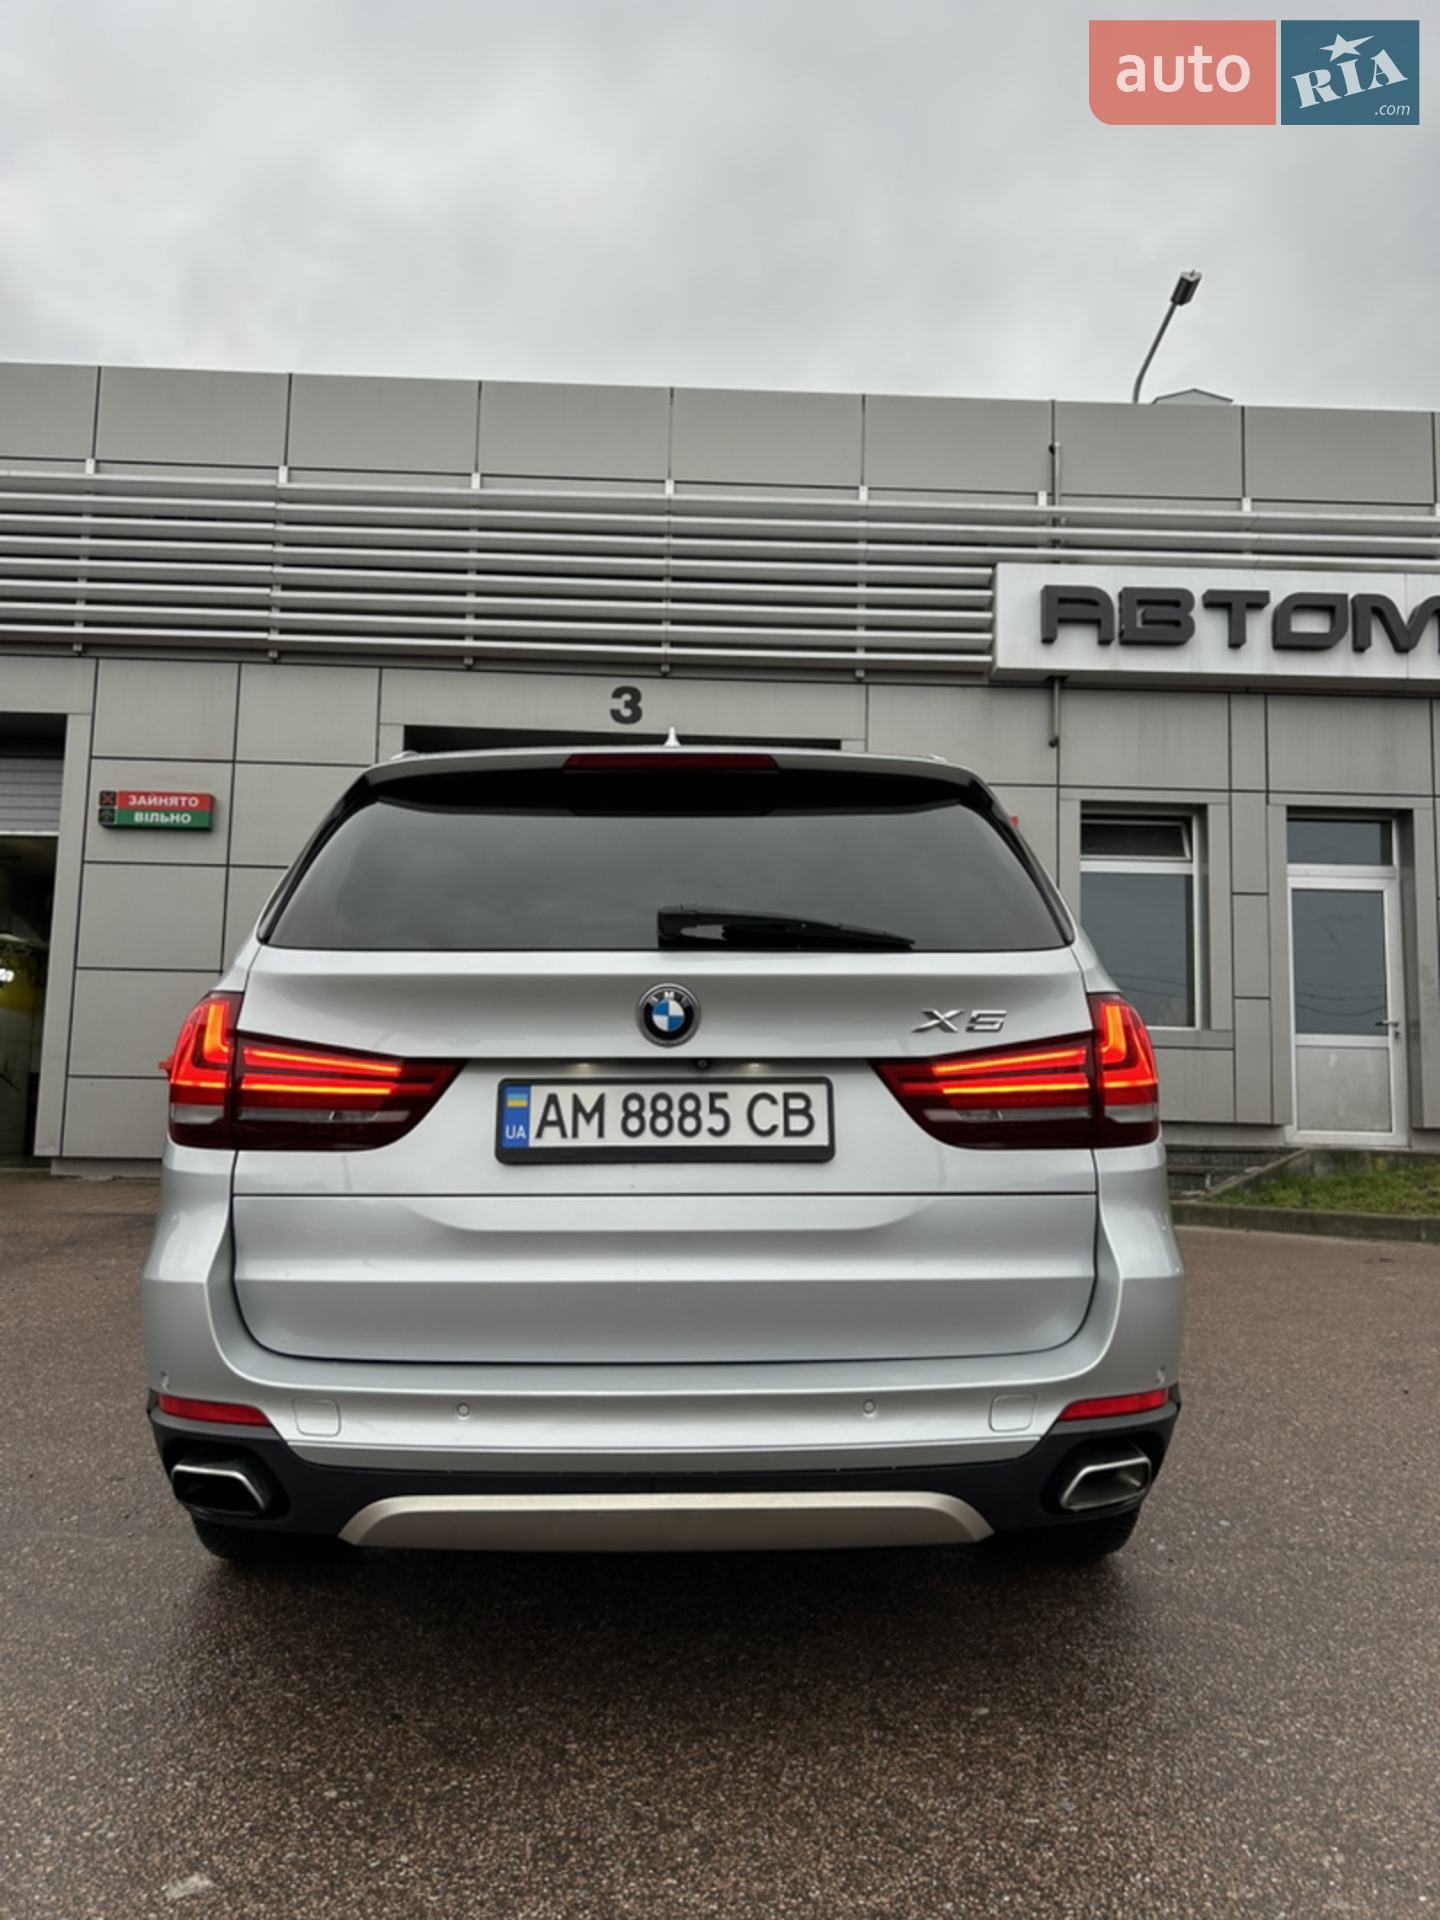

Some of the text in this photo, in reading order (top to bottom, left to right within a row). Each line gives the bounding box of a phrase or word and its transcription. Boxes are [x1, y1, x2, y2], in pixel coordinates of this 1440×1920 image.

[610, 685, 643, 725] 3
[128, 793, 200, 808] ЗАЙНЯТО
[134, 811, 192, 824] ВІЛЬНО
[911, 1008, 1008, 1033] X5
[534, 1091, 816, 1140] AM 8885 CB
[505, 1124, 527, 1140] UA
